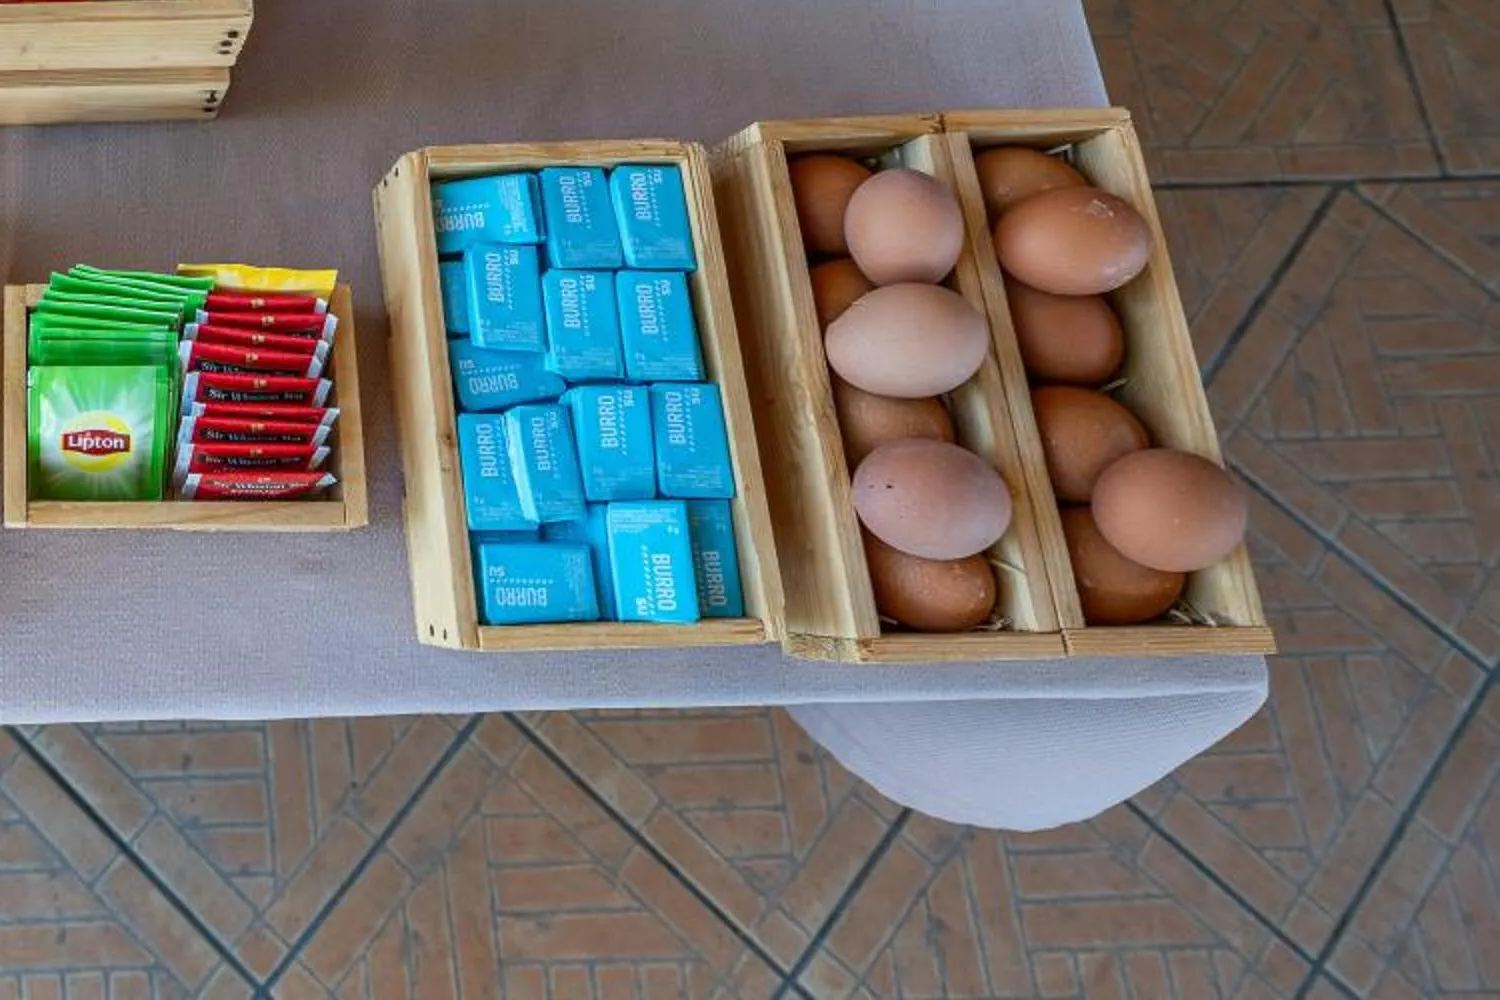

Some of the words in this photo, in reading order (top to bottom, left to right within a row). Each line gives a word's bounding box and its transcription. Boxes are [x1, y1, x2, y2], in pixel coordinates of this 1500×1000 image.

[559, 175, 582, 223] BURRO
[630, 172, 651, 221] BURRO
[485, 252, 504, 303] BURRO
[560, 279, 581, 328] BURRO
[635, 283, 659, 335] BURRO
[67, 431, 125, 450] Lipton
[531, 416, 551, 472] BURRO
[598, 395, 620, 449] BURRO
[665, 391, 688, 445] BURRO
[476, 422, 498, 478] BURRO
[495, 587, 548, 607] BURRO
[651, 552, 678, 612] BURRO
[702, 551, 728, 607] BURRO
